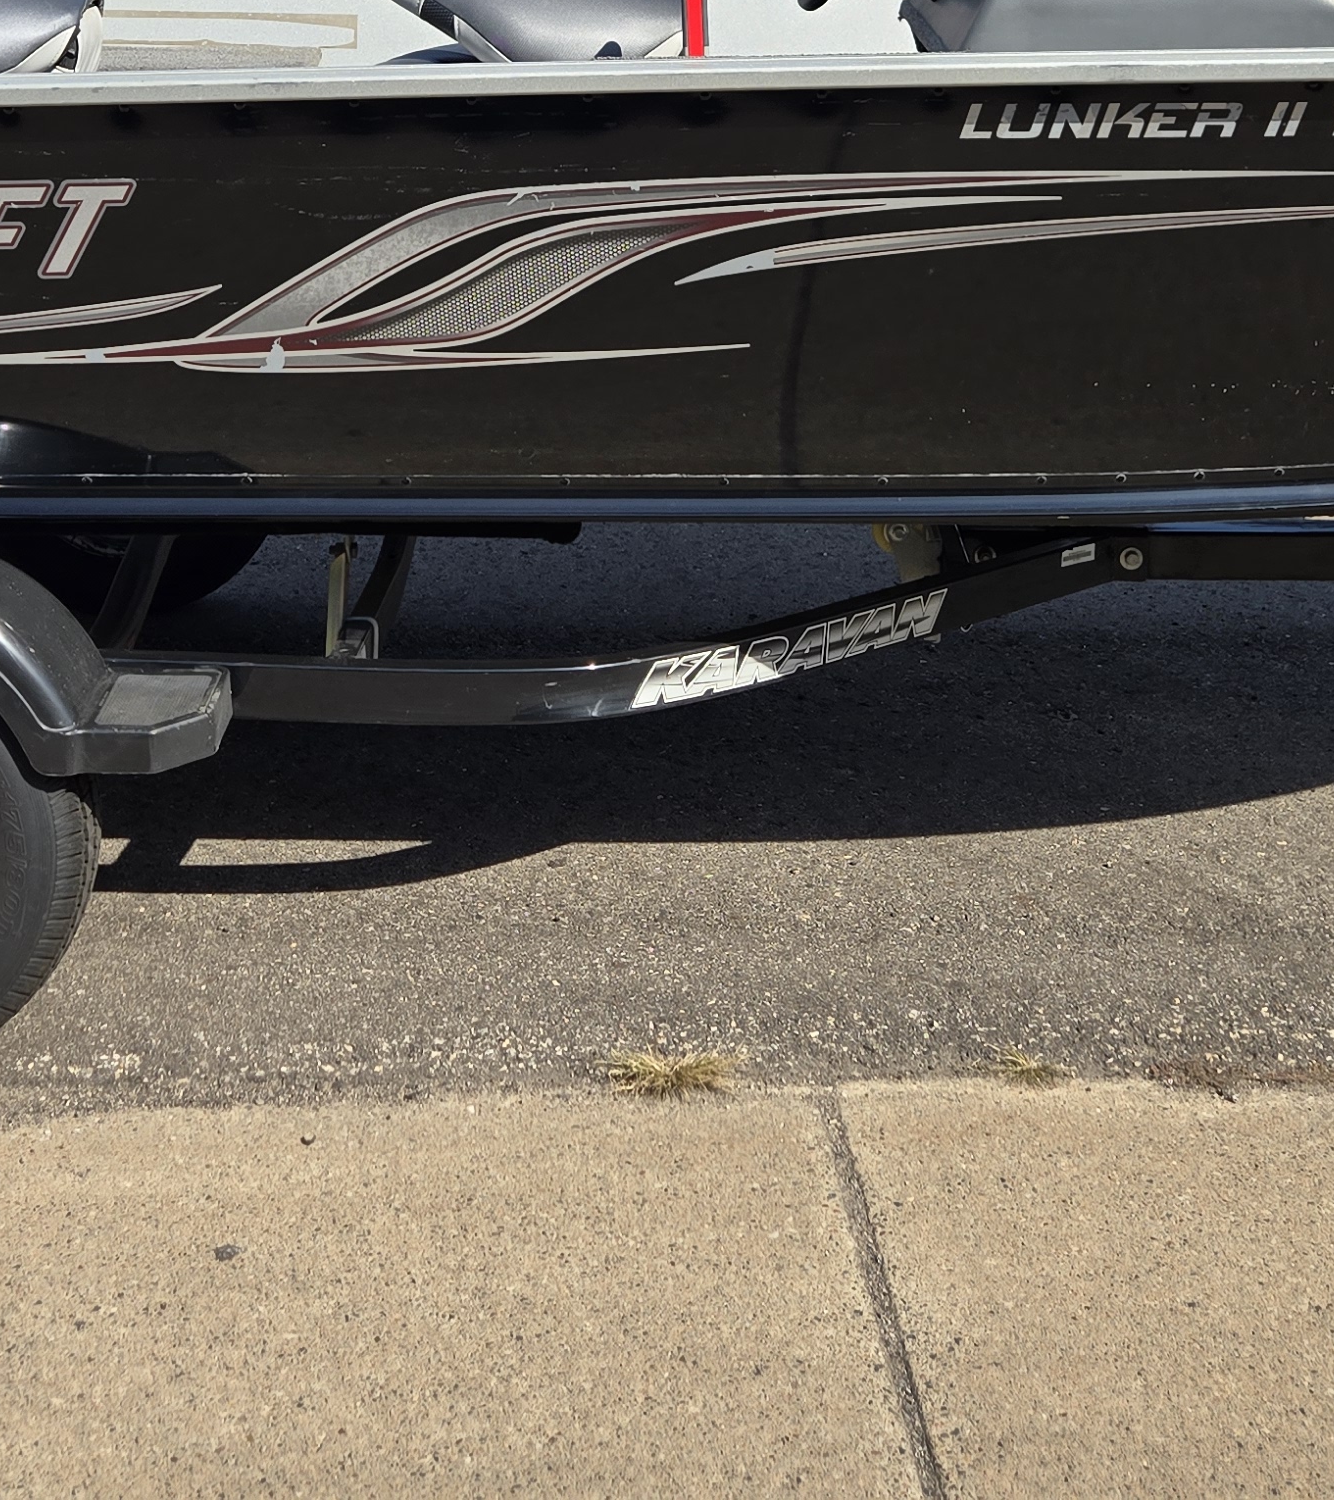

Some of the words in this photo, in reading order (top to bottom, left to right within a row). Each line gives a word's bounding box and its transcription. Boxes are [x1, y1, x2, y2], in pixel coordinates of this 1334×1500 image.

[959, 102, 1244, 139] LUNKER
[1264, 101, 1309, 137] II
[629, 588, 949, 710] KARAVAN
